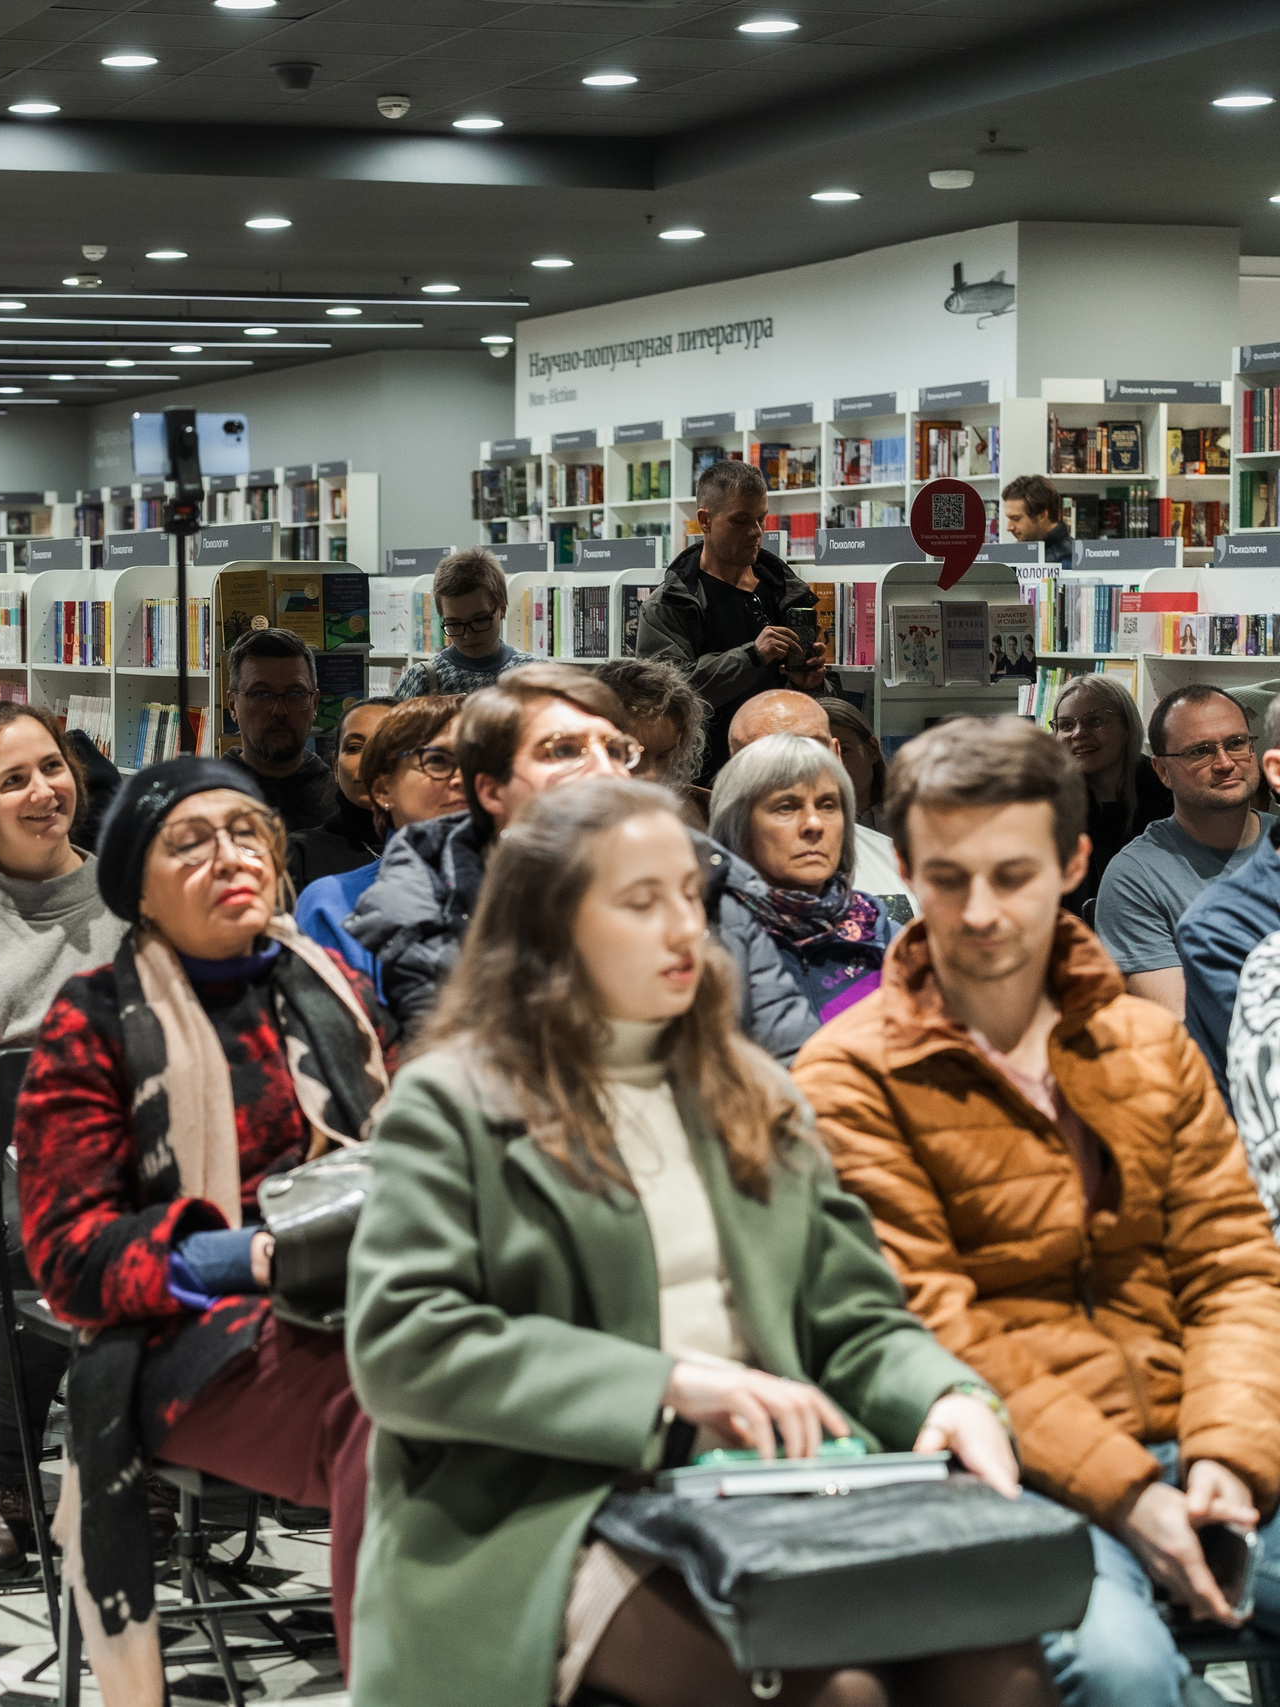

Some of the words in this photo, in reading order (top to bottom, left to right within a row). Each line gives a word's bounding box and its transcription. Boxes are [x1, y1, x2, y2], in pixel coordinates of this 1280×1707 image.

[528, 334, 673, 382] Научно-популярная
[675, 316, 774, 354] литература
[829, 538, 866, 550] Психология
[1228, 544, 1267, 555] Психология
[1085, 548, 1120, 558] Психология
[1016, 567, 1060, 580] ХОЛОГИЯ
[946, 621, 984, 629] МУЖЧИНА
